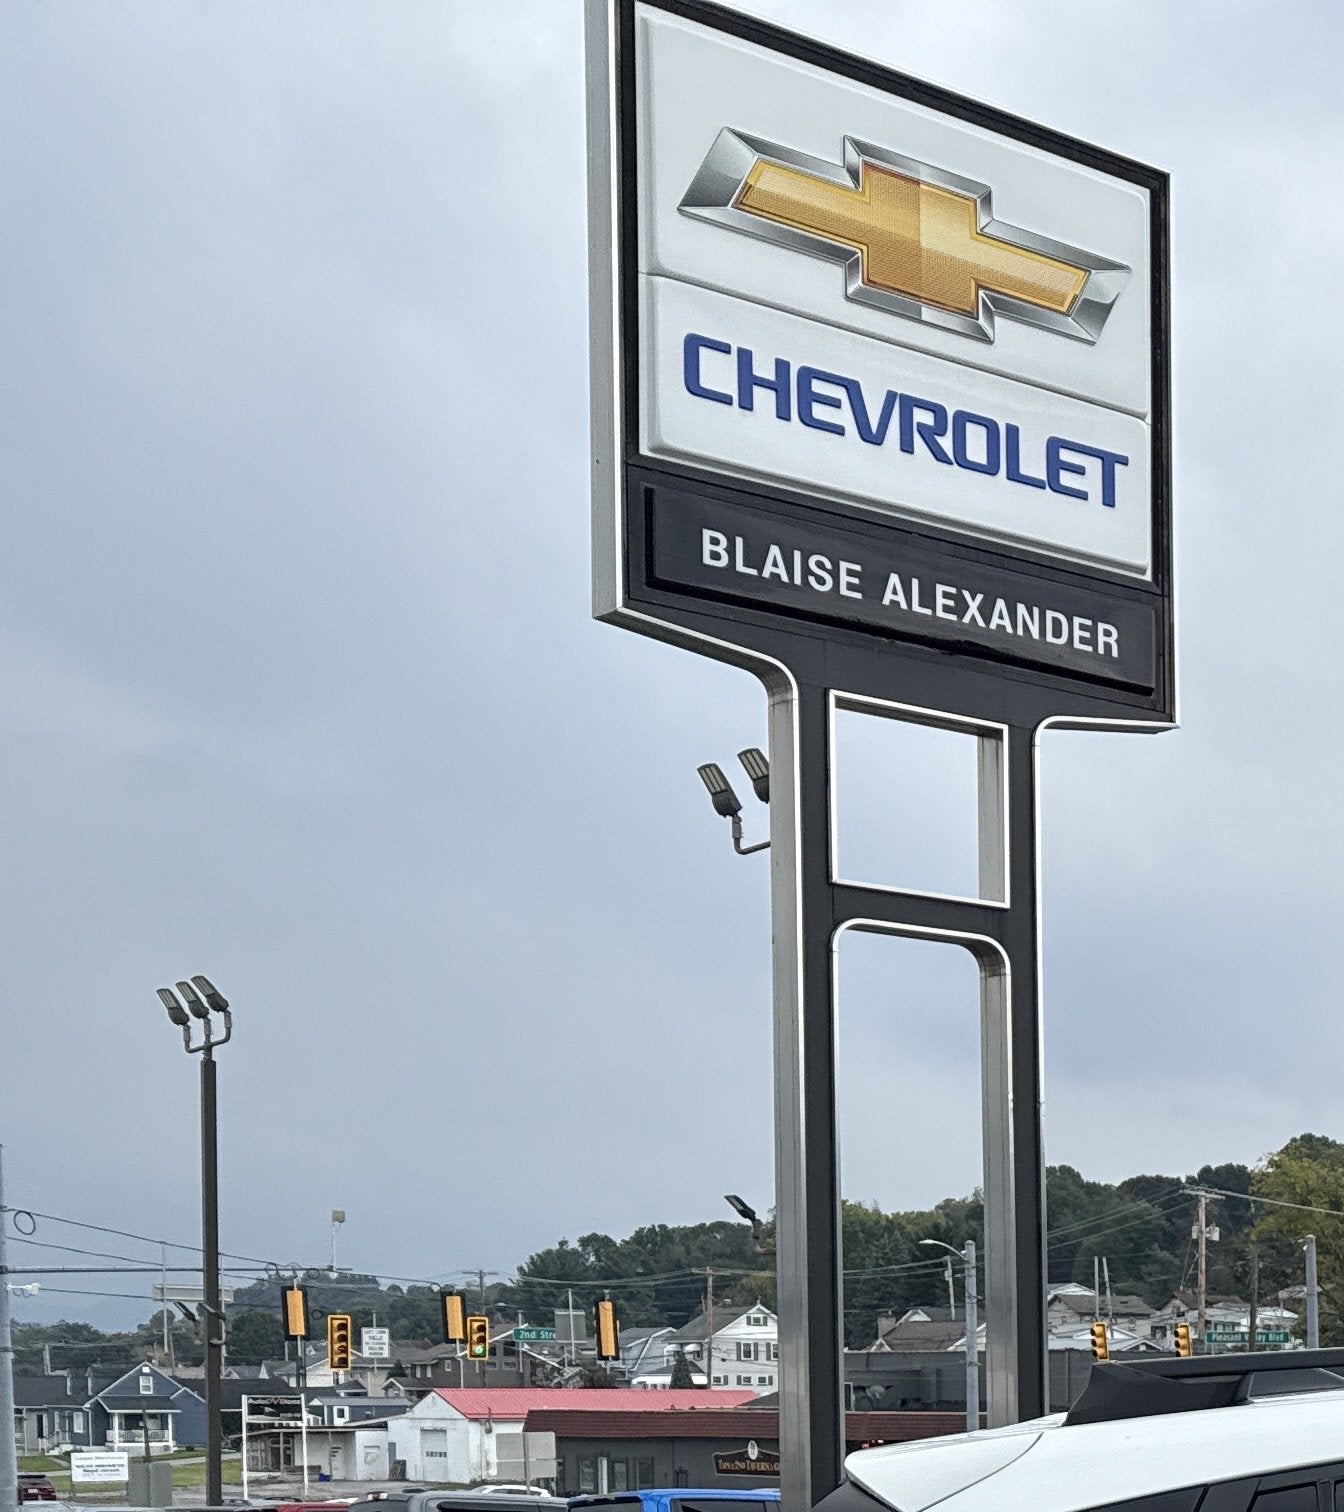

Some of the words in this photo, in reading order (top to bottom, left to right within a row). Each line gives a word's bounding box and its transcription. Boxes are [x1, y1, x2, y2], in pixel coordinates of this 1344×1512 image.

[683, 332, 1129, 508] CHEVROLET
[702, 528, 863, 600] BLAISE
[882, 572, 1119, 659] ALEXANDER
[519, 1331, 537, 1339] 2nd
[1212, 1333, 1242, 1341] Pleasant
[1268, 1333, 1284, 1342] Blvd
